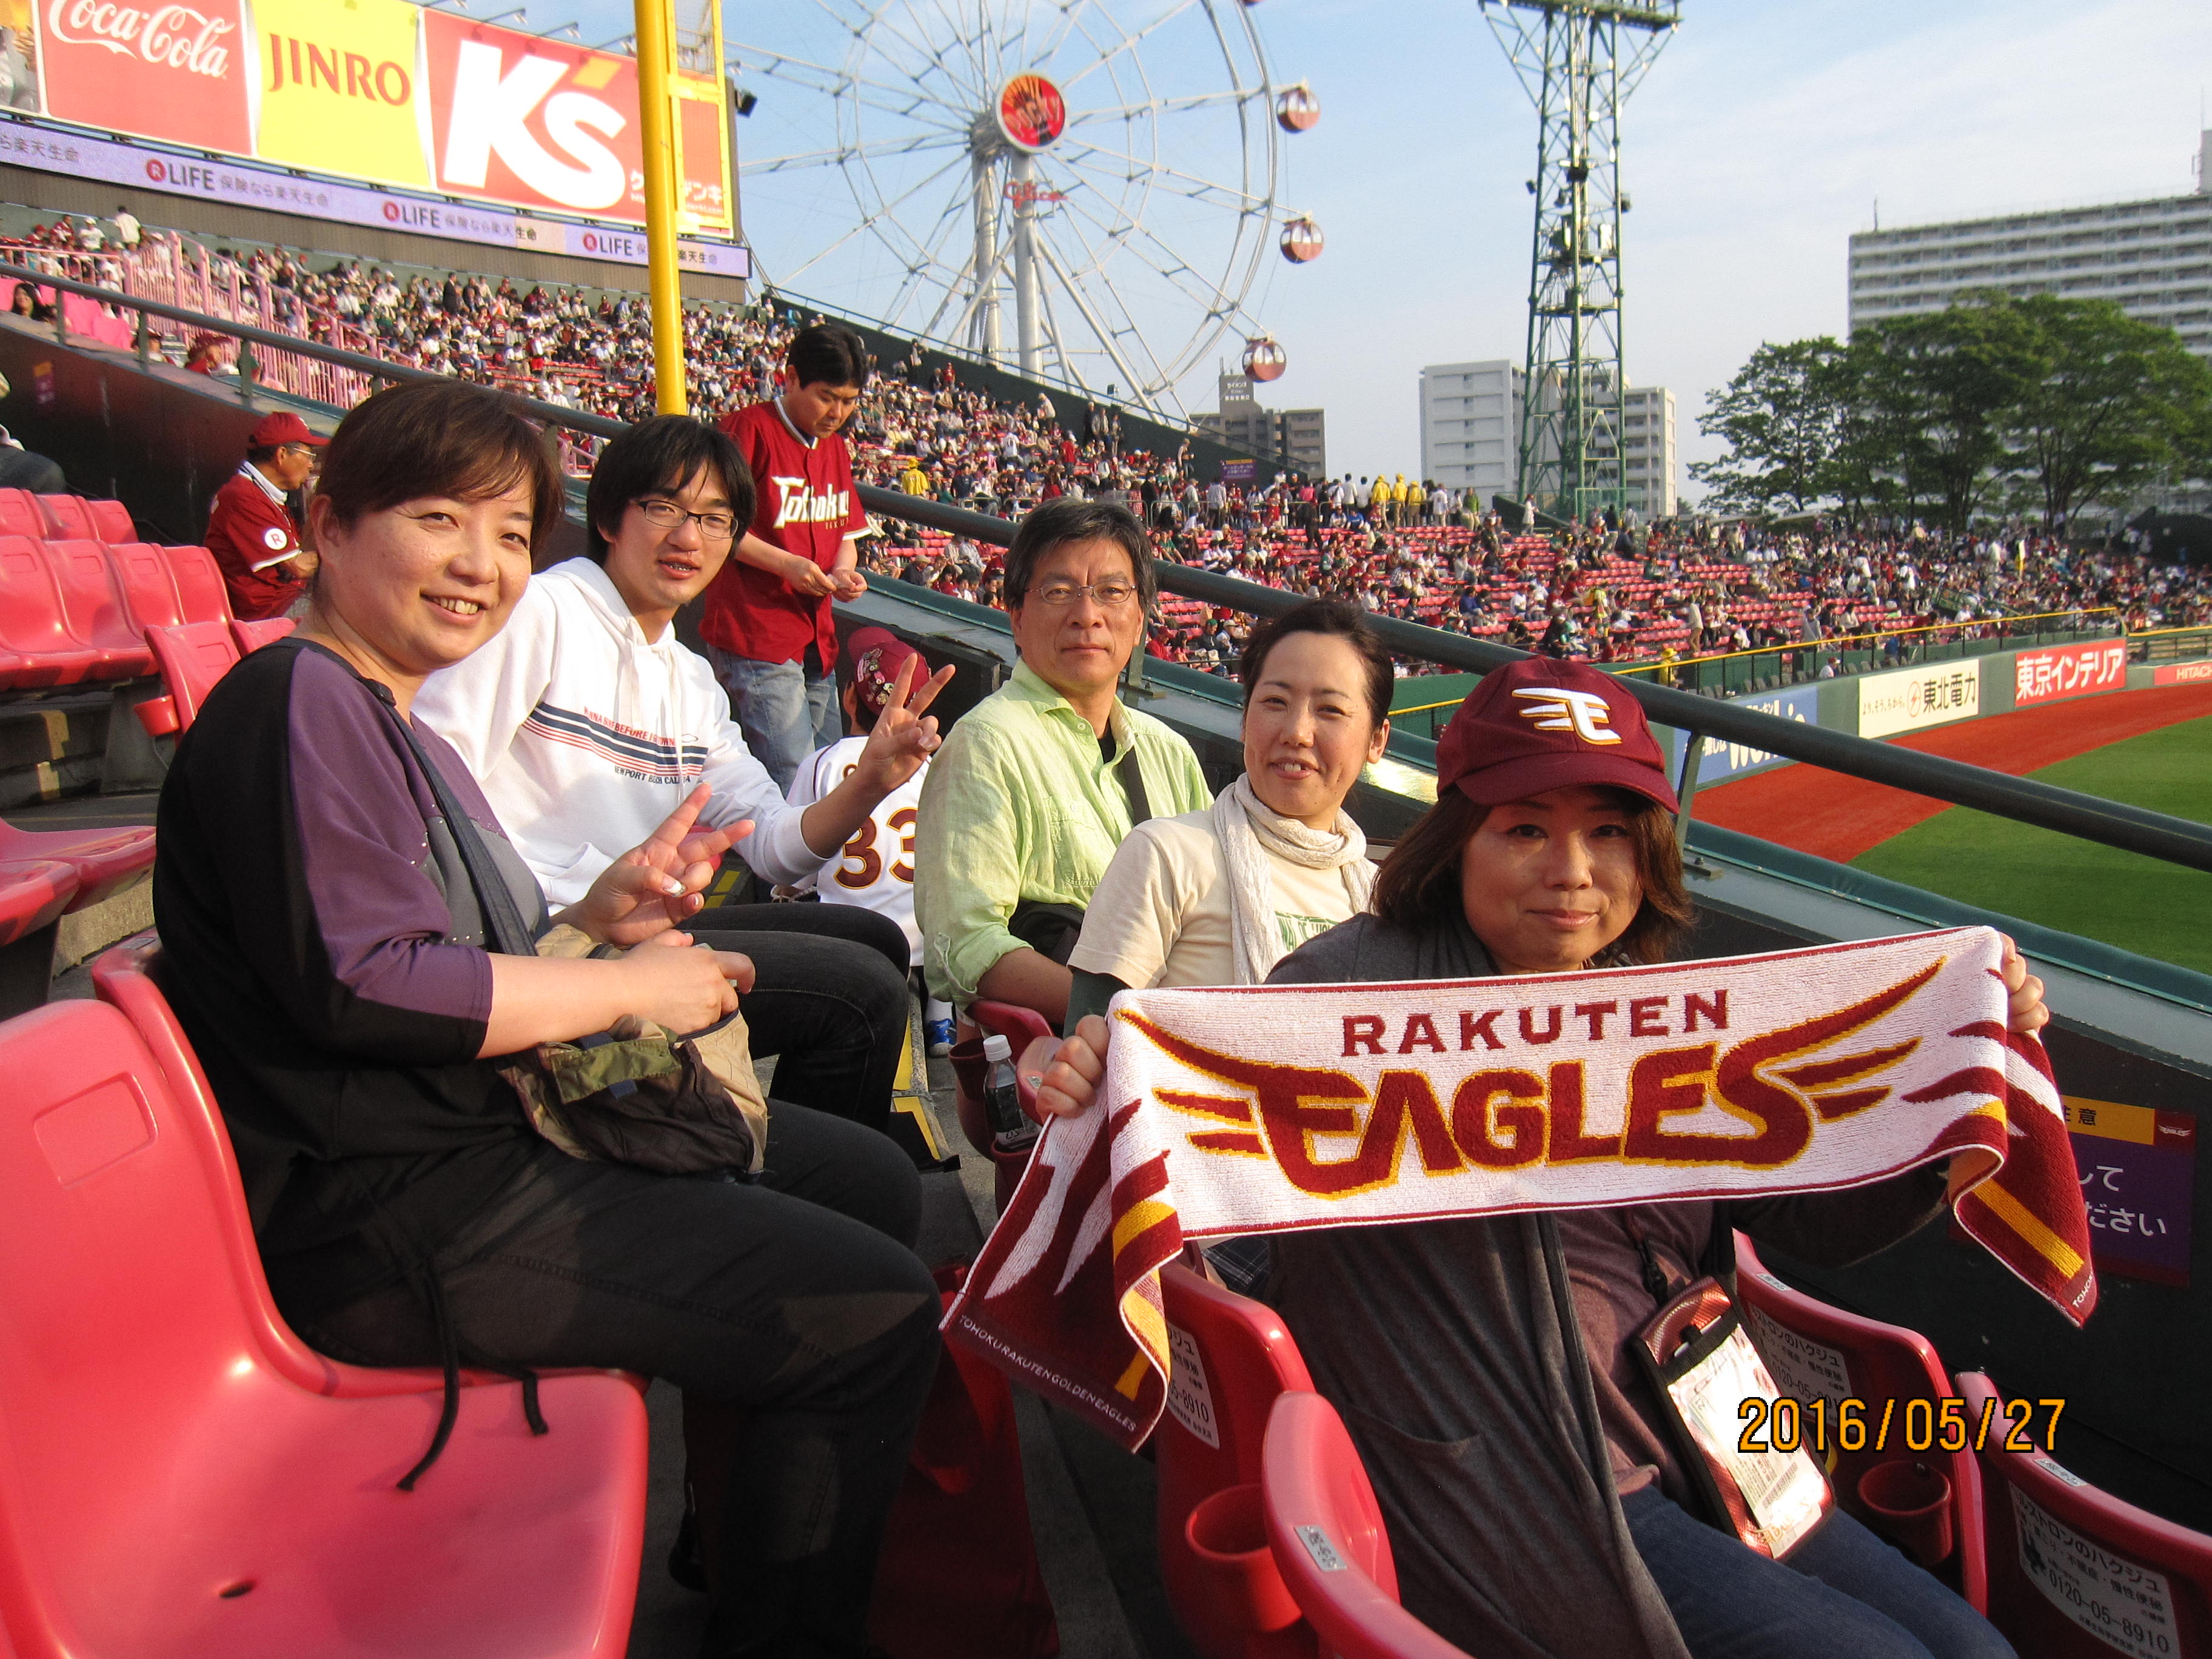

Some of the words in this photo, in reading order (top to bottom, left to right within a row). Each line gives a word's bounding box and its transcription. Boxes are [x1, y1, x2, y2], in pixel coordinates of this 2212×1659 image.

[49, 0, 236, 78] Coca-Cola
[268, 33, 411, 106] JINRO
[169, 162, 215, 191] LIFE
[402, 204, 441, 228] LIFE
[599, 236, 632, 256] LIFE
[771, 475, 849, 529] Tohoku
[1923, 671, 1976, 714] 東北電力
[2016, 648, 2123, 700] 東京インテリア
[615, 722, 648, 740] BEFORE
[1341, 988, 1729, 1056] RAKUTEN
